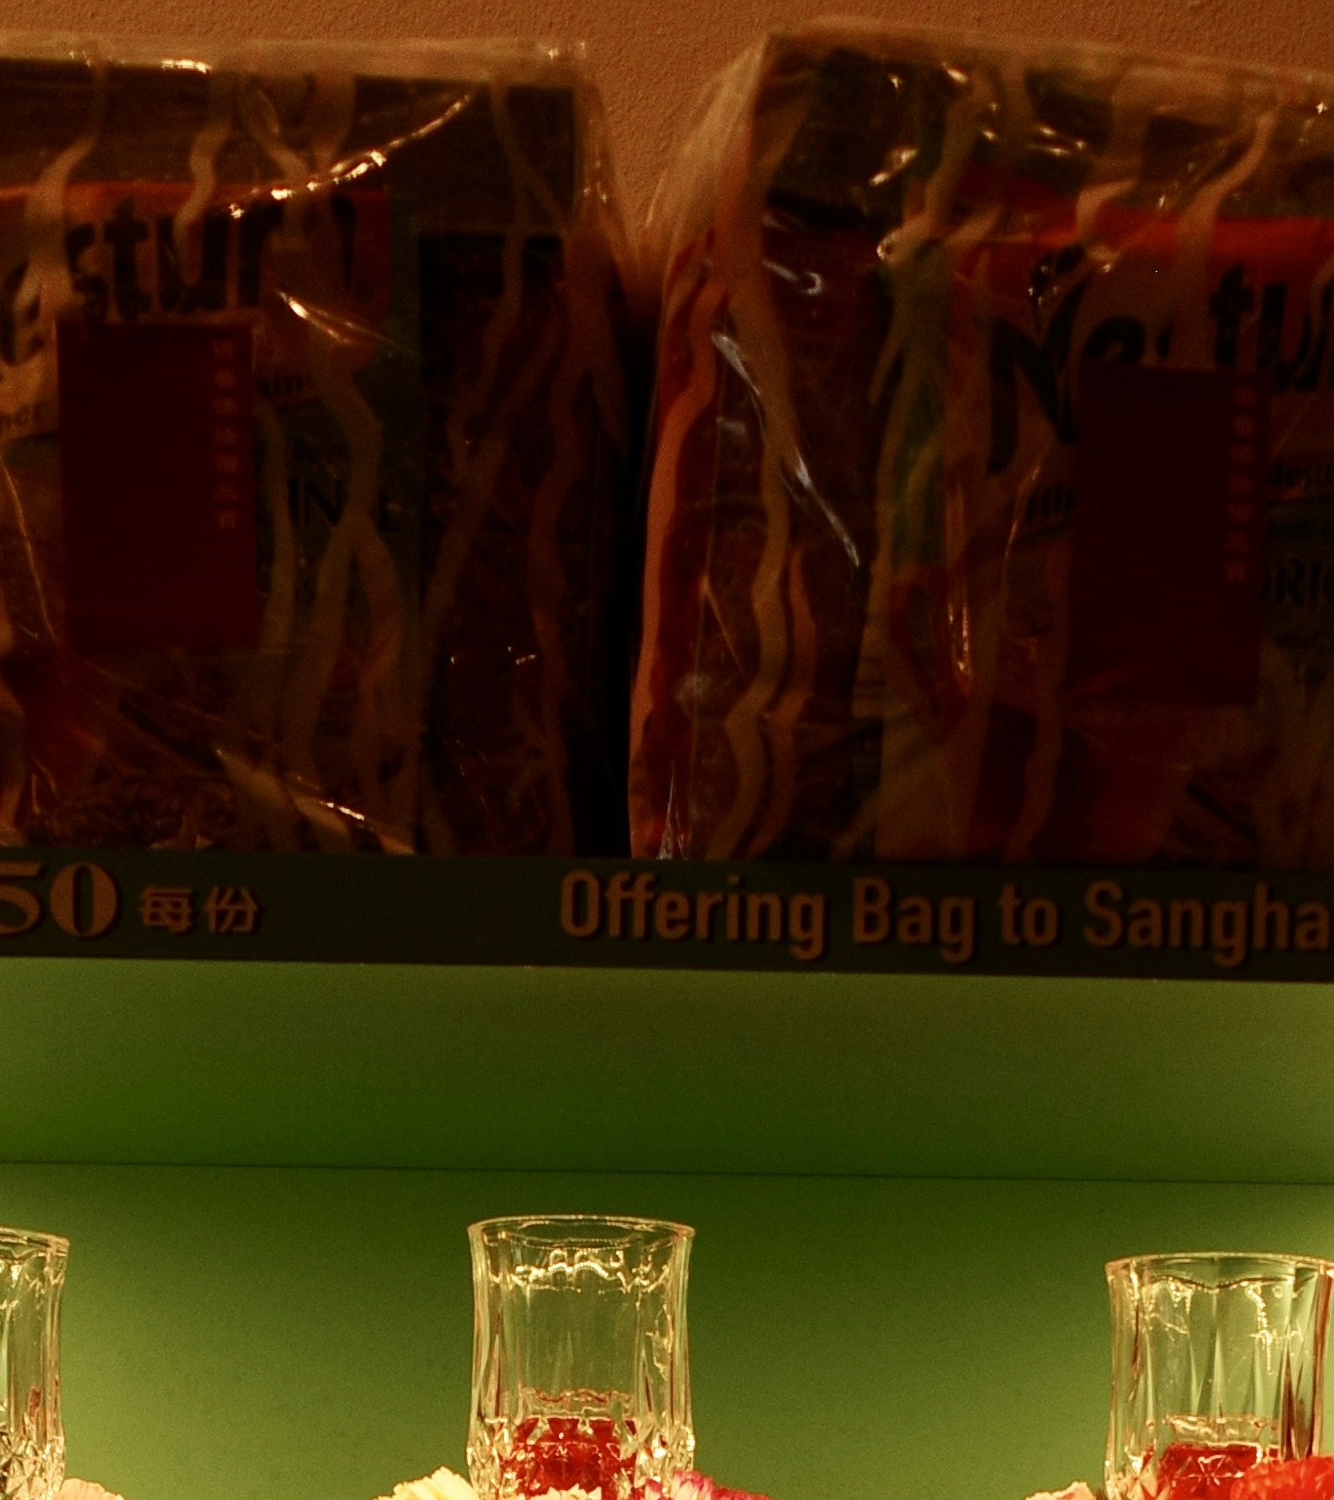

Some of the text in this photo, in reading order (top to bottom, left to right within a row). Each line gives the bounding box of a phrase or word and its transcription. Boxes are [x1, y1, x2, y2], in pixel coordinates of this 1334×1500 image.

[138, 884, 261, 936] 每份
[560, 868, 827, 961] Offering
[850, 876, 979, 966] Bag
[997, 881, 1061, 950] to
[1083, 879, 1333, 970] Sangha
